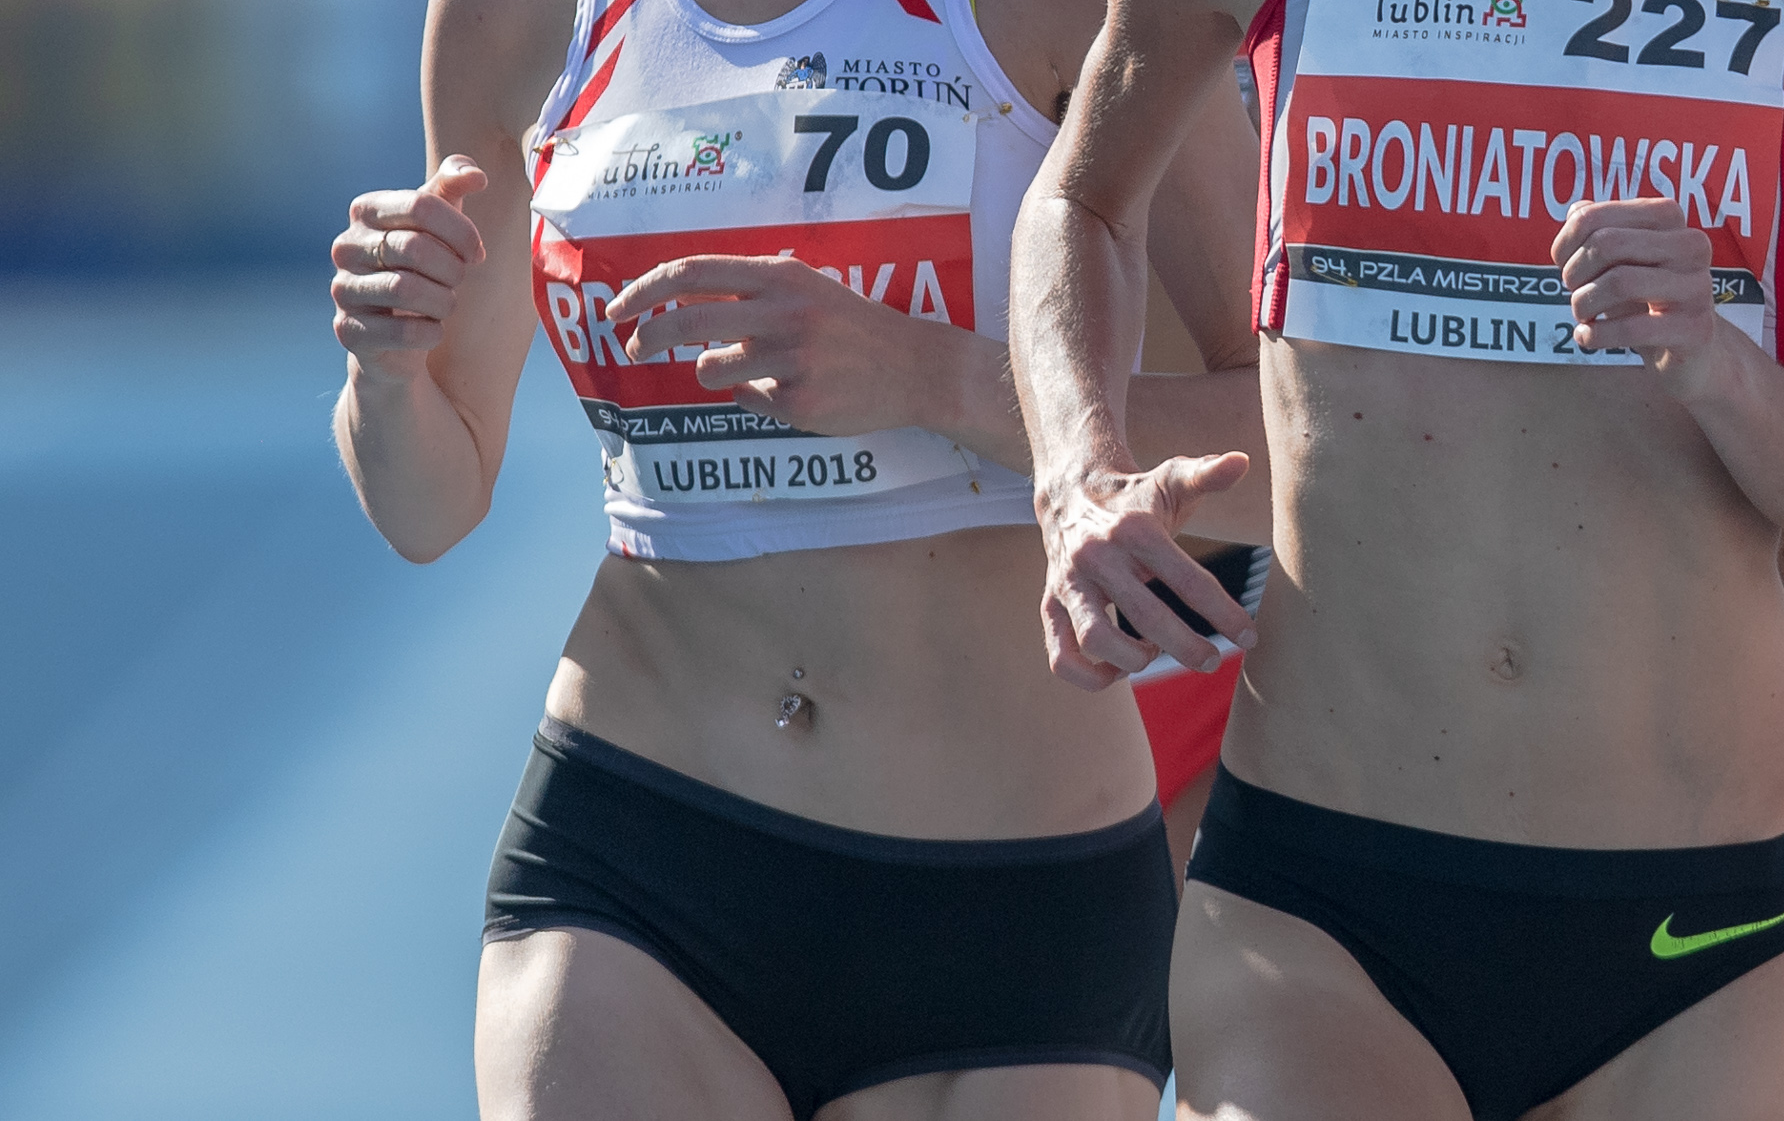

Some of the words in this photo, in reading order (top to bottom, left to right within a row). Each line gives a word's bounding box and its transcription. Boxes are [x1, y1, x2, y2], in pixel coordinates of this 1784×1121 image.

[1372, 29, 1429, 40] MIASTO
[1437, 30, 1527, 46] INSPIRACJI
[842, 59, 941, 77] MIASTO
[592, 143, 679, 185] ublin
[794, 114, 930, 192] 70
[587, 187, 637, 200] MIASTO
[644, 181, 723, 195] INSPIRACJI
[1305, 115, 1752, 239] BRONIATOWSKA
[1311, 256, 1352, 277] 94.
[1359, 260, 1426, 286] PZLA
[1432, 268, 1572, 296] MISTRZO
[1390, 309, 1536, 353] LUBLIN
[653, 456, 776, 491] LUBLIN
[788, 450, 877, 487] 2018
